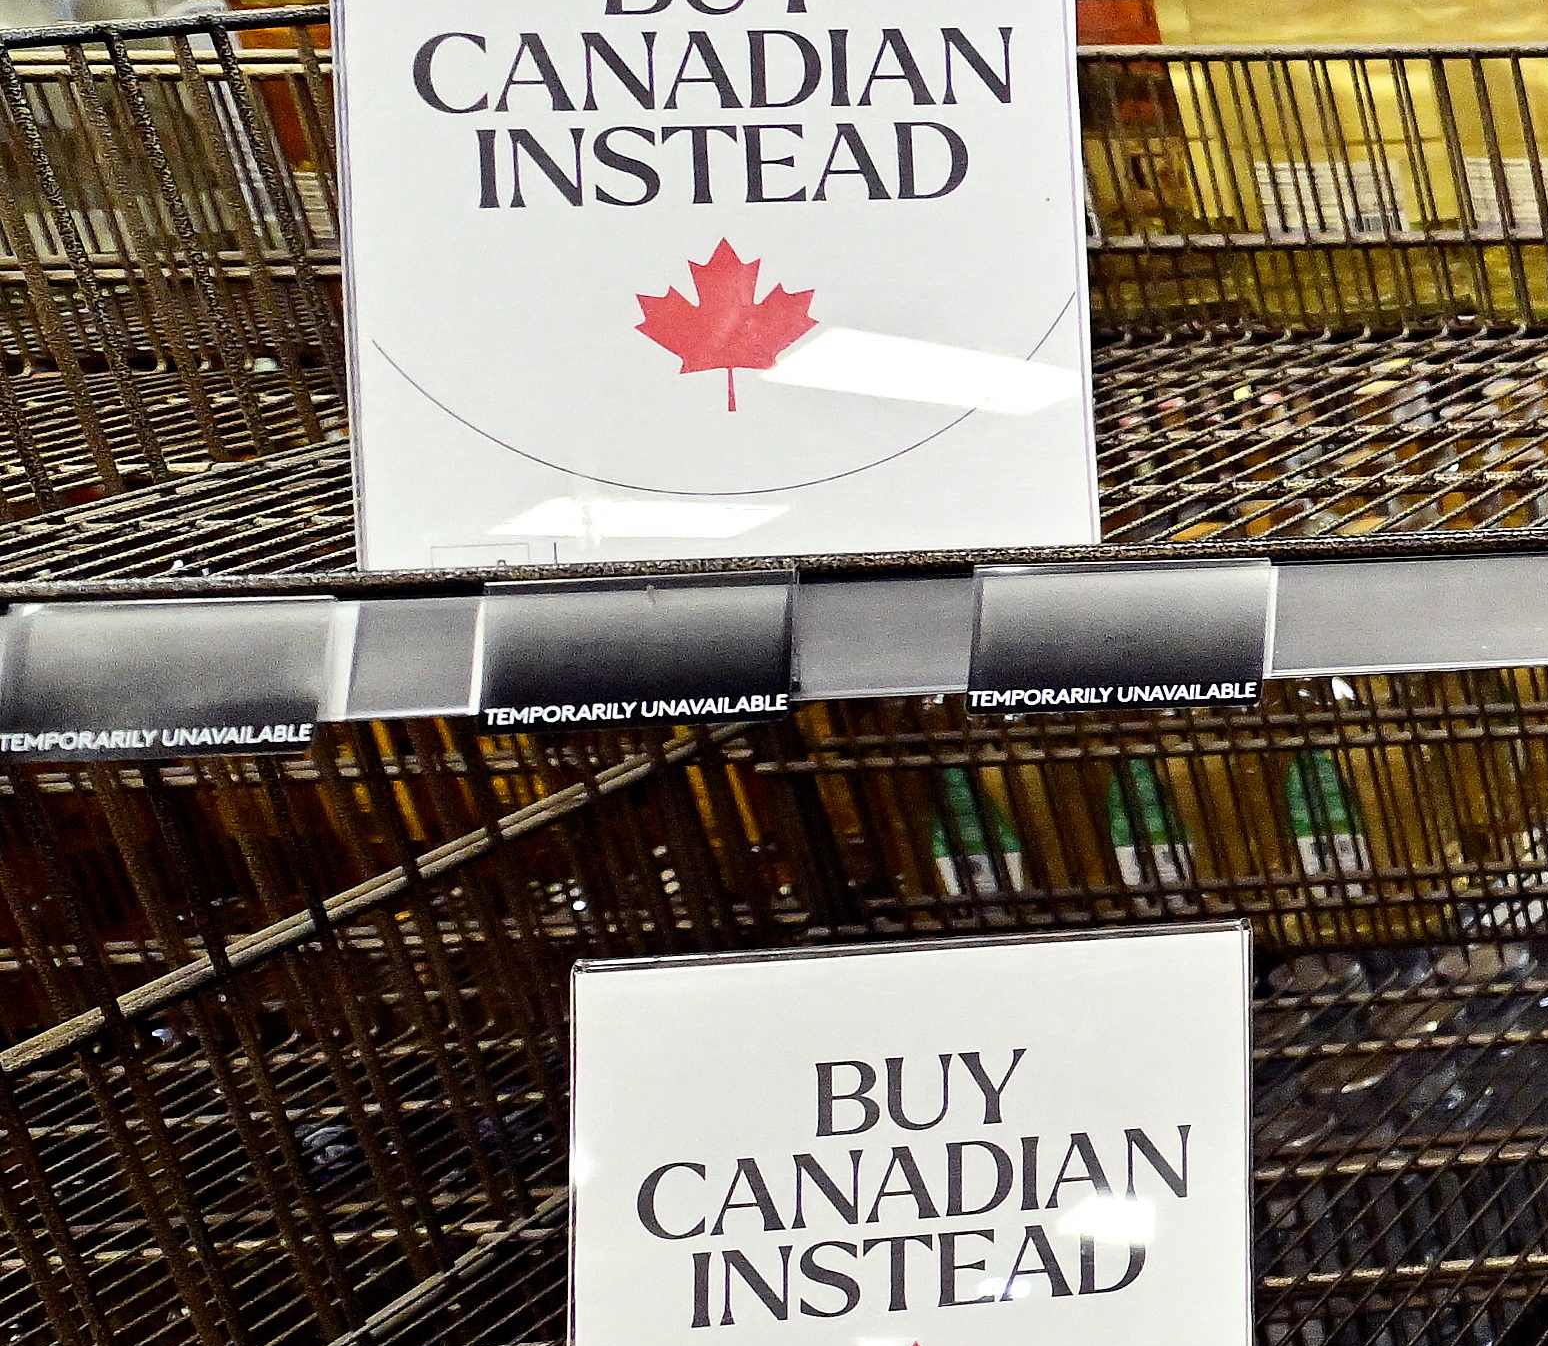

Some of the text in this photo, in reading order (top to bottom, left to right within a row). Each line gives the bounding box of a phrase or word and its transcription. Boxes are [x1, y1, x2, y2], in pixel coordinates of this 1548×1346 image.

[413, 27, 1012, 114] CANADIAN
[478, 122, 968, 209] INSTEAD
[0, 723, 313, 752] TEMPORARILY UNAVAILABLE
[485, 694, 788, 725] TEMPORARILY UNAVAILABLE
[968, 682, 1256, 707] TEMPORARILY UNAVAILABLE
[815, 1049, 1027, 1137] BUY
[636, 1125, 1191, 1241] CANADIAN
[691, 1226, 1146, 1329] INSTEAD
